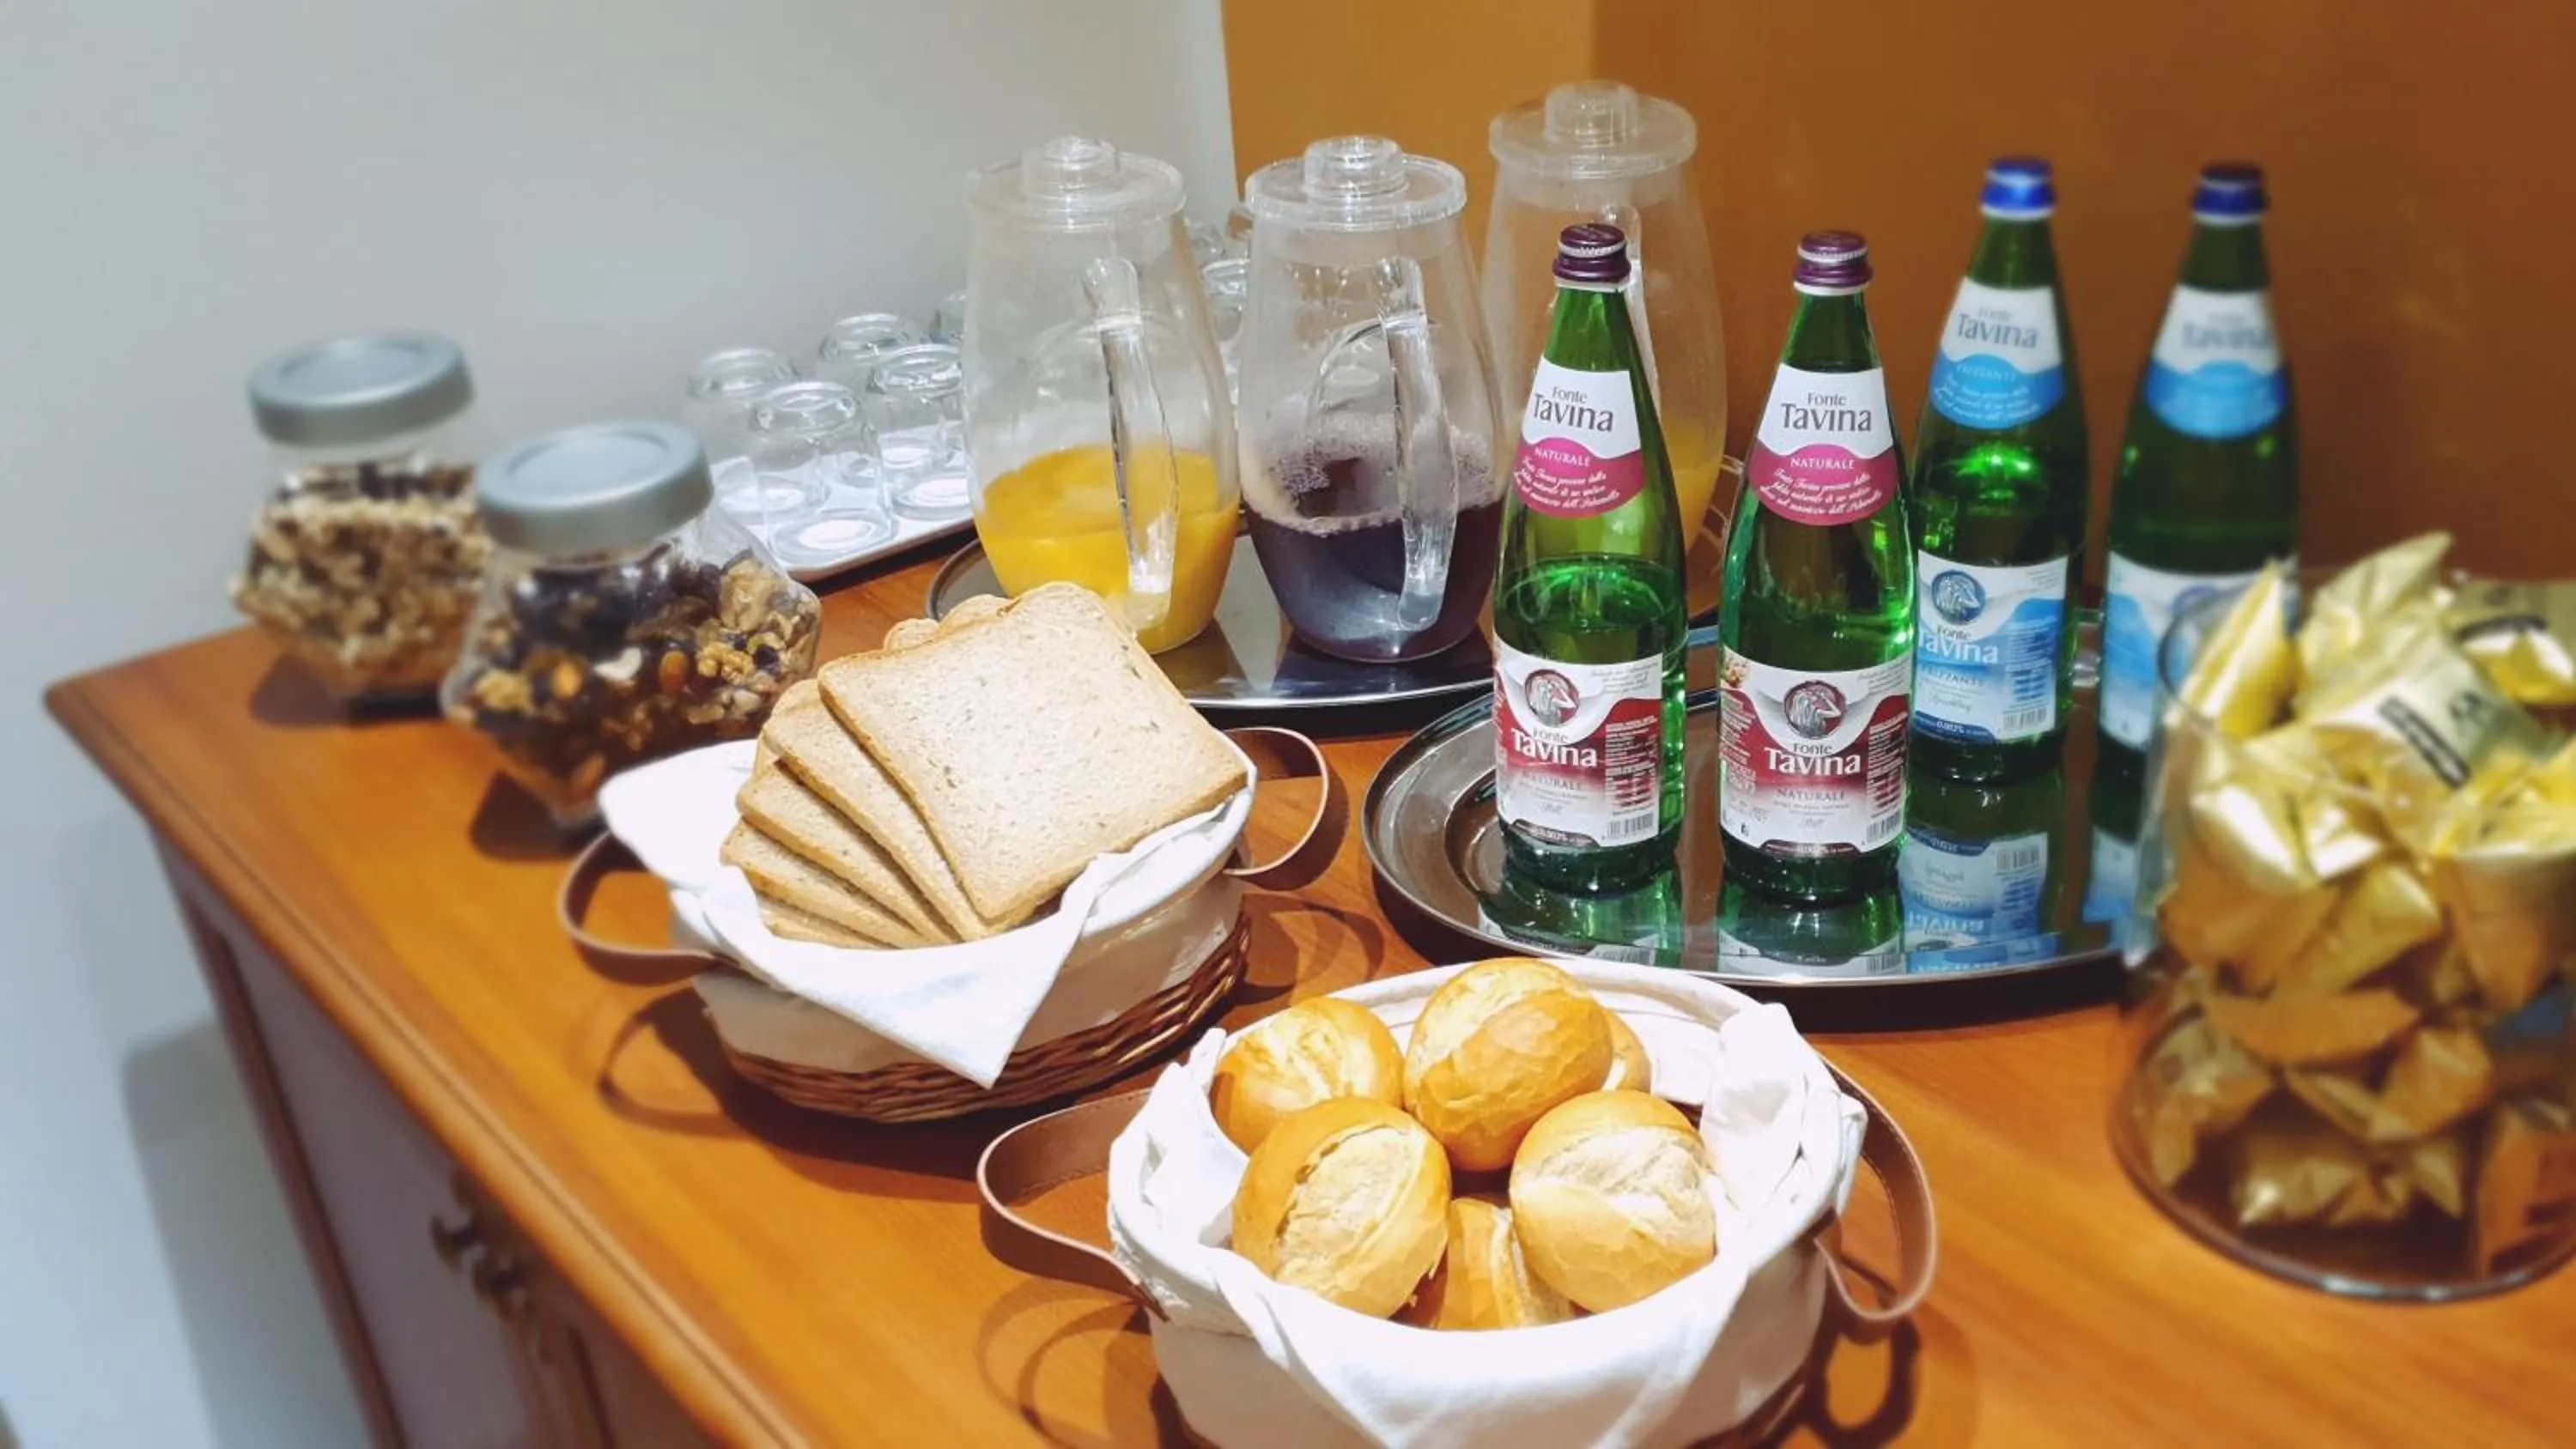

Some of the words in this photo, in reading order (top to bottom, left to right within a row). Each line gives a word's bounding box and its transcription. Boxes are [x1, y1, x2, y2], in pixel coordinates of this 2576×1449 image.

[1957, 313, 2038, 349] Tavina
[1552, 385, 1588, 403] Fonte
[1807, 392, 1848, 407] Fonte
[1533, 393, 1614, 432] Tavina
[1781, 403, 1872, 432] Tavina
[1534, 446, 1590, 468] NATURALE
[1790, 457, 1855, 470] NATURALE
[1936, 626, 1971, 641] Fonte
[1918, 630, 2000, 665] Tavina
[1534, 727, 1570, 743] Fonte
[1510, 726, 1599, 768] Tavina
[1793, 742, 1834, 755] Fonte
[1764, 746, 1862, 776] Tavina
[1776, 787, 1846, 802] NATURALE
